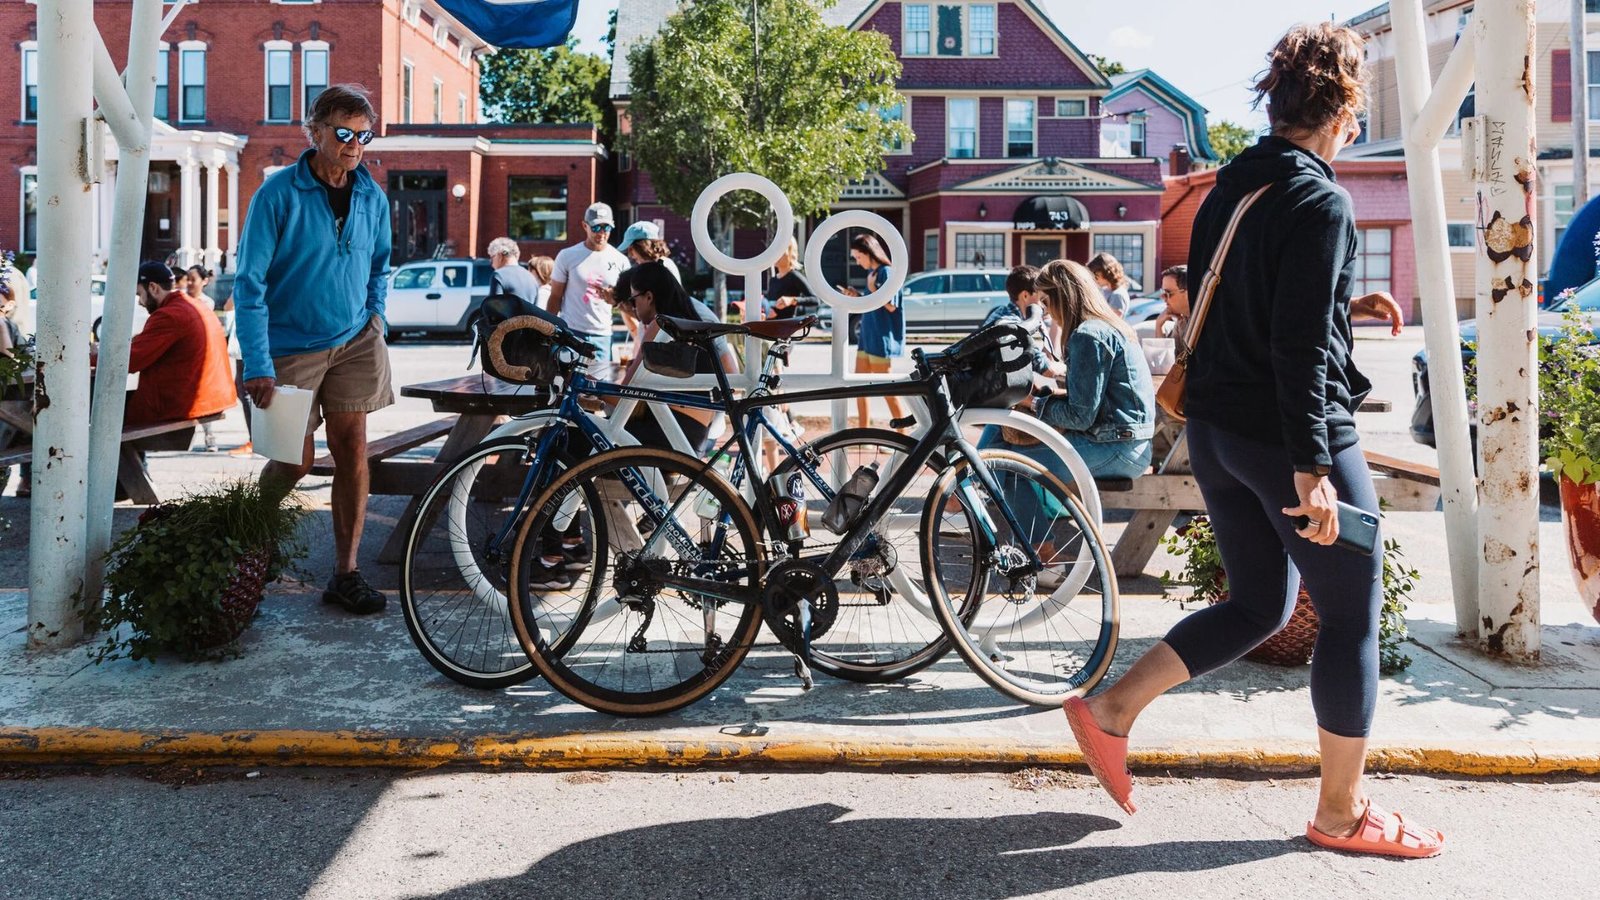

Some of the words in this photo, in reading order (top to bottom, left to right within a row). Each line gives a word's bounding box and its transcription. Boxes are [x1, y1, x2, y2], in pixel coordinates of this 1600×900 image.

[1049, 211, 1069, 221] 743
[592, 432, 667, 519] caondale
[665, 520, 702, 560] IRONCLAD
